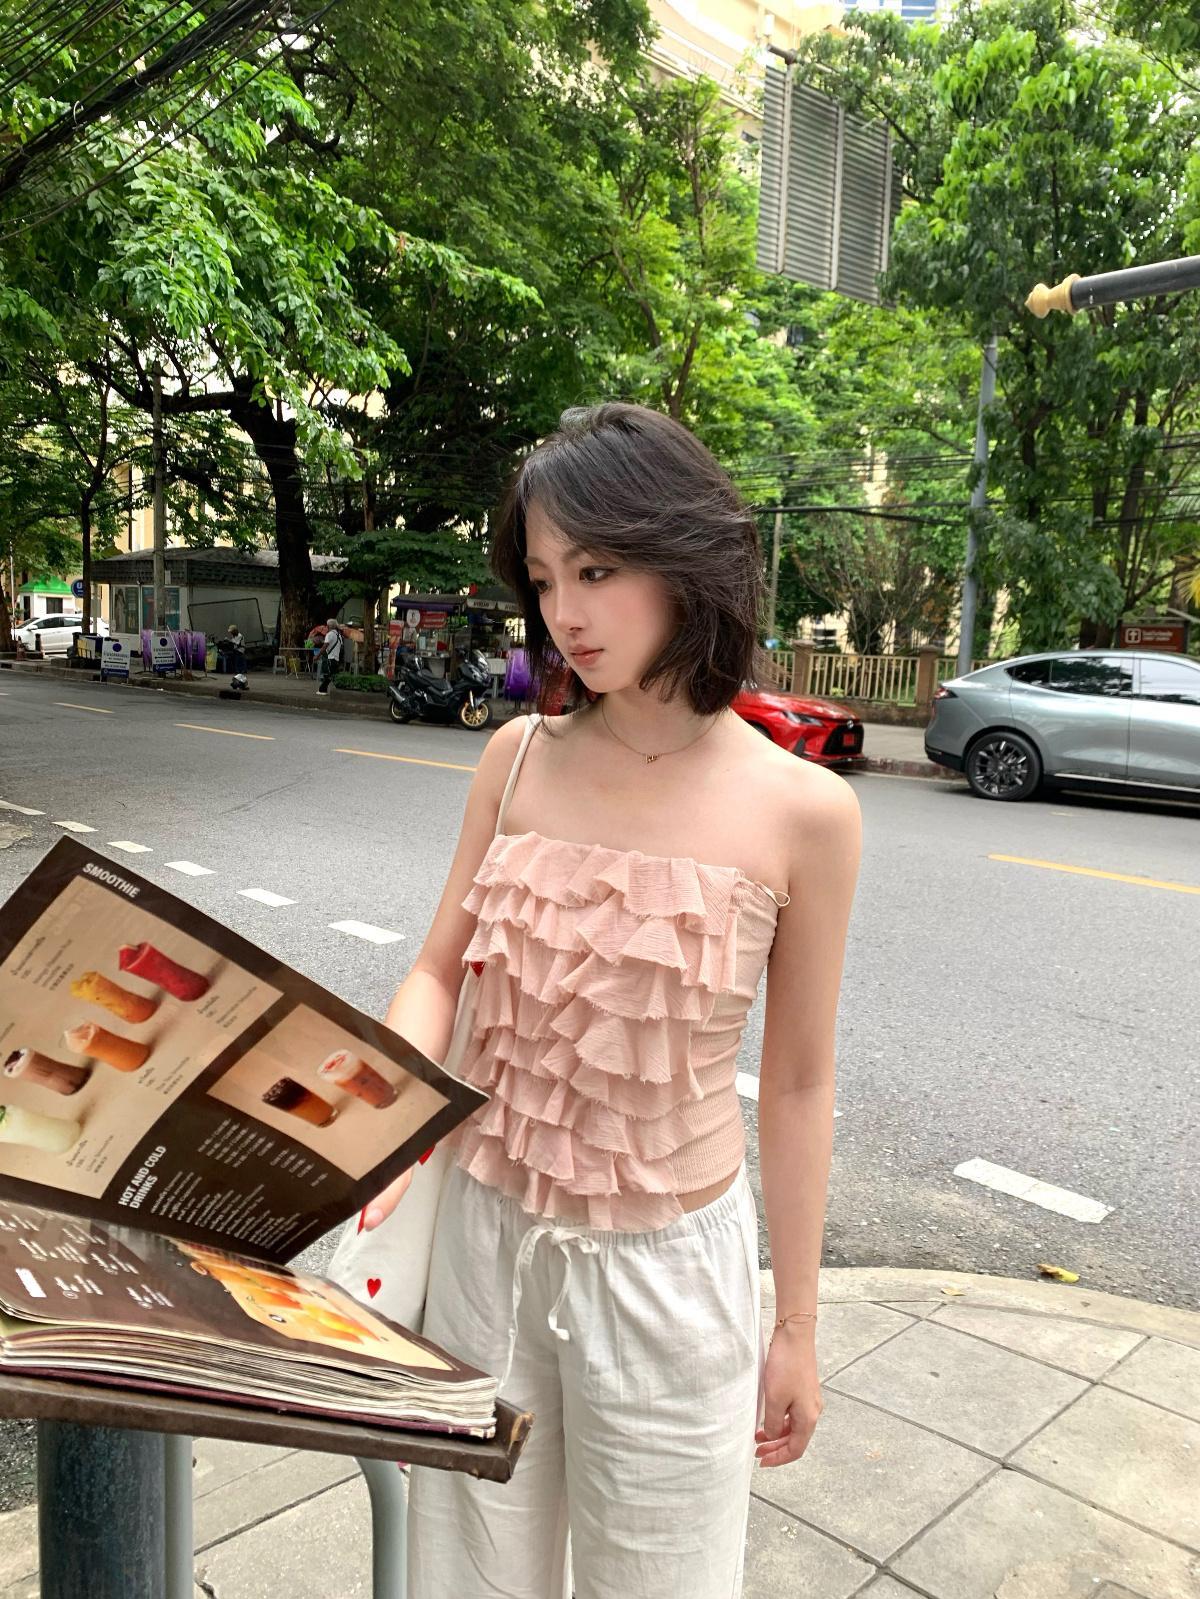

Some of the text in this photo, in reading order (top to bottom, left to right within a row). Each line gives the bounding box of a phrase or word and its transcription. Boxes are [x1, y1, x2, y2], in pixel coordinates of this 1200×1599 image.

[82, 862, 140, 898] SMOOTHIE
[118, 1145, 167, 1206] HOT AND COLD
[129, 1175, 158, 1209] DRINKS
